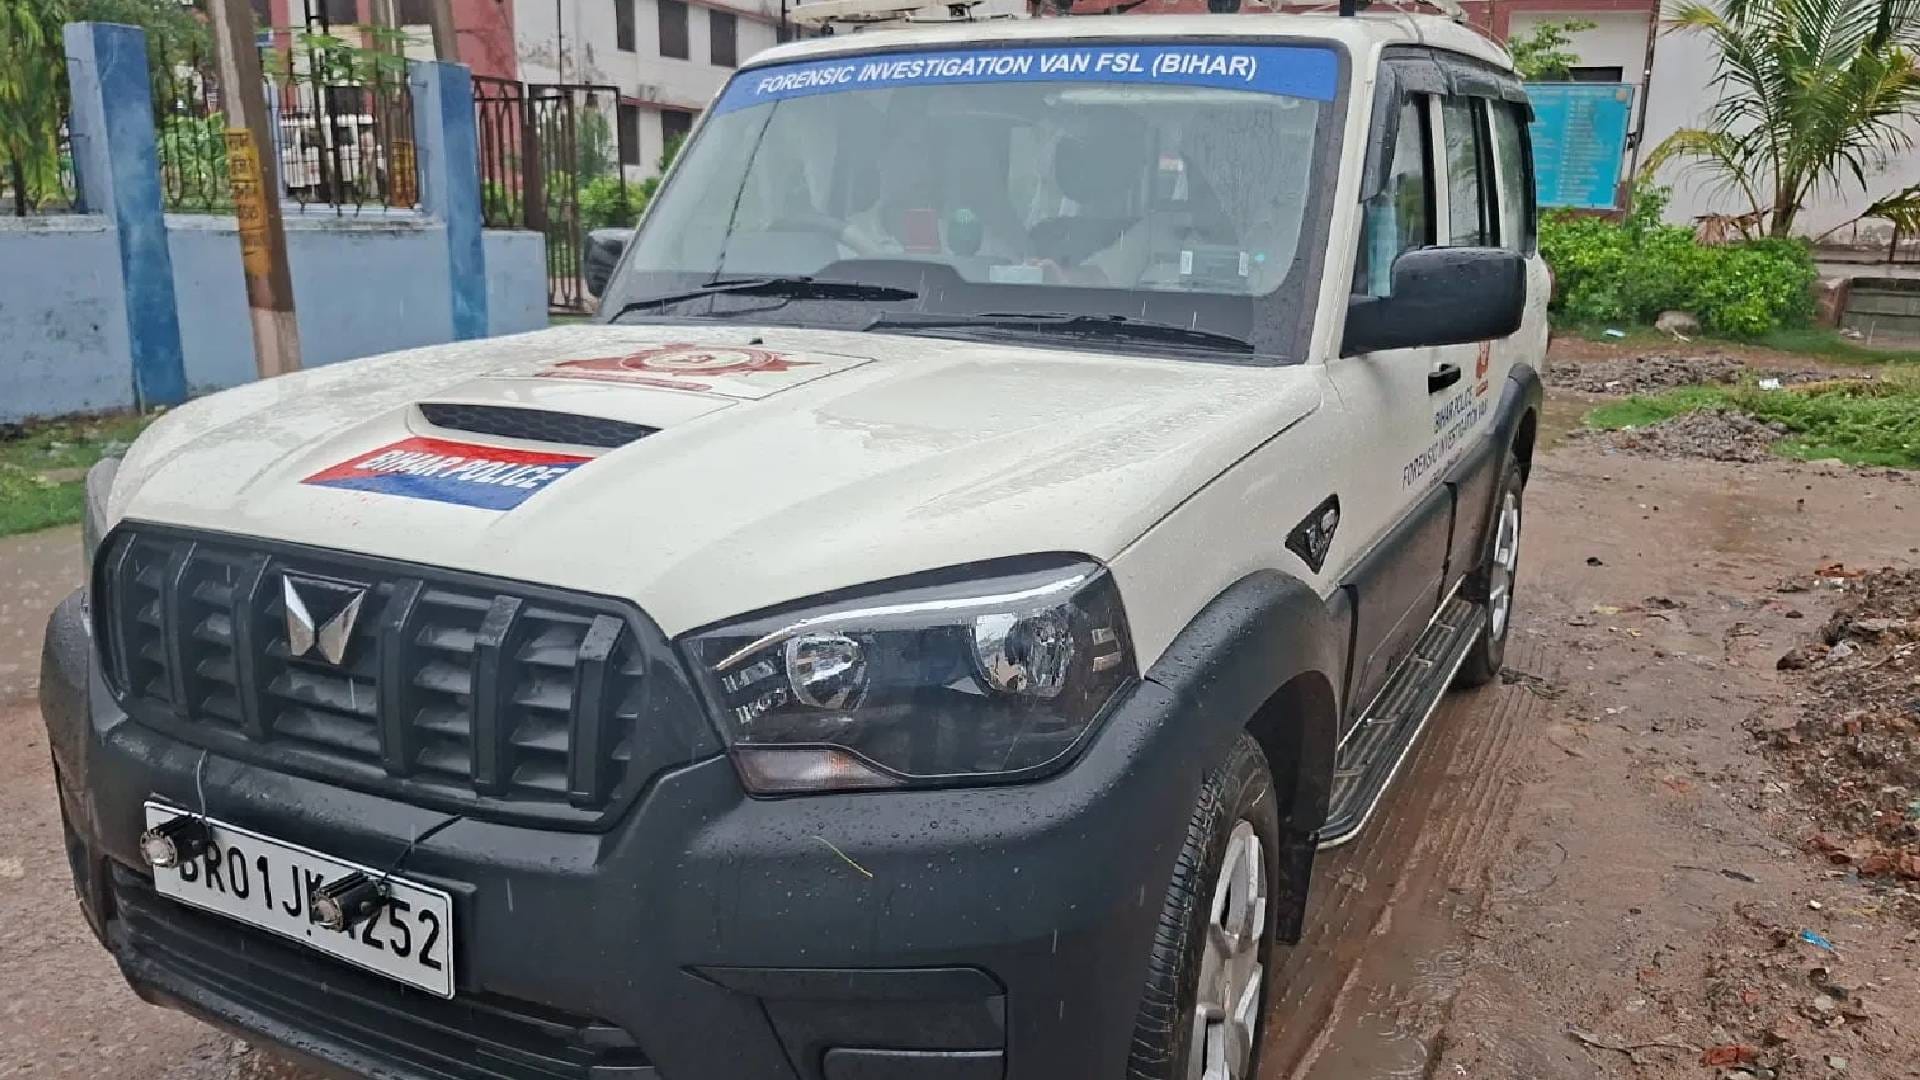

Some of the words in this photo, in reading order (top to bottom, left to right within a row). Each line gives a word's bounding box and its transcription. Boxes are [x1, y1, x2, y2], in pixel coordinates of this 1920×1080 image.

[757, 66, 855, 95] FORENSIC
[858, 55, 1034, 82] INVESTIGATION
[1041, 54, 1091, 74] VAN
[1095, 53, 1144, 73] FSL
[1152, 53, 1257, 81] (BIHAR)
[353, 449, 446, 477] BIHAR
[438, 456, 570, 489] POLICE
